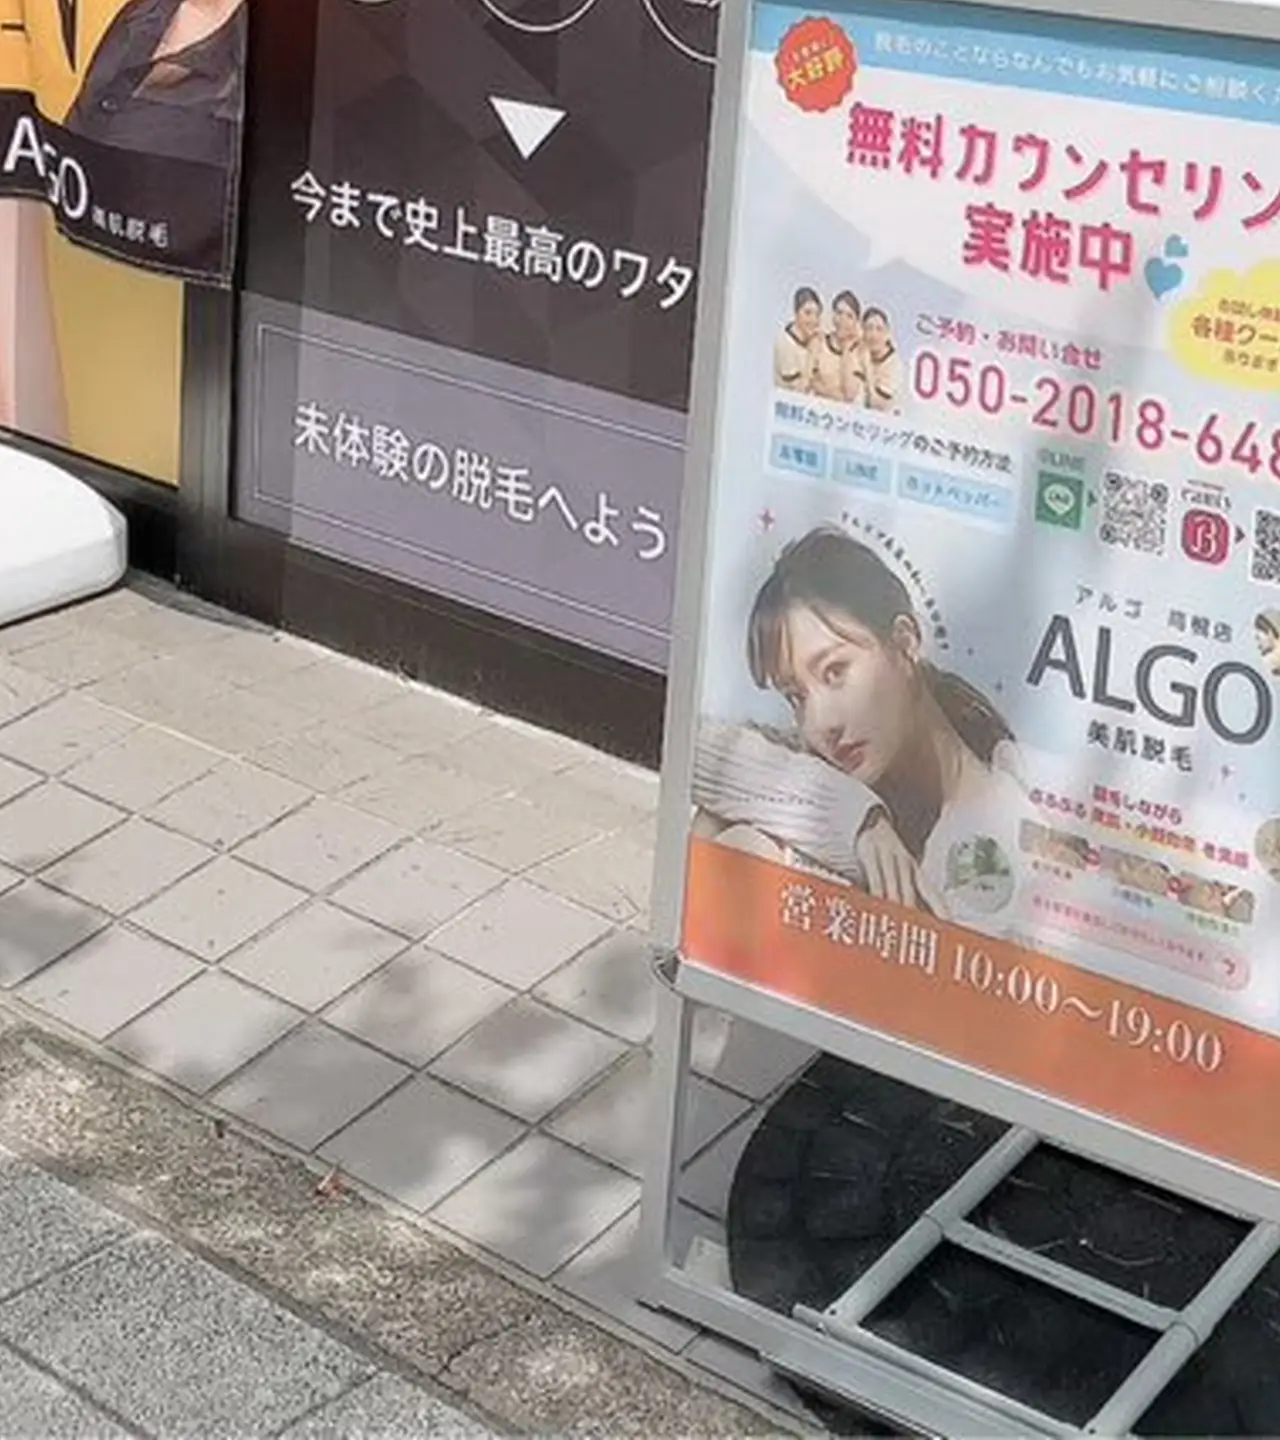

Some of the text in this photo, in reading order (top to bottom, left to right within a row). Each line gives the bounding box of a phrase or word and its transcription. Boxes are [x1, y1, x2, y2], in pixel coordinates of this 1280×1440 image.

[290, 171, 695, 310] 今まで史上最高のワタ
[962, 202, 1135, 293] 実施中
[293, 400, 669, 561] 未体験の脱毛へよう
[1076, 584, 1144, 620] アルゴ
[1024, 613, 1274, 746] ALGO
[1087, 719, 1193, 772] 美肌脱毛
[780, 883, 940, 976] 営業時間
